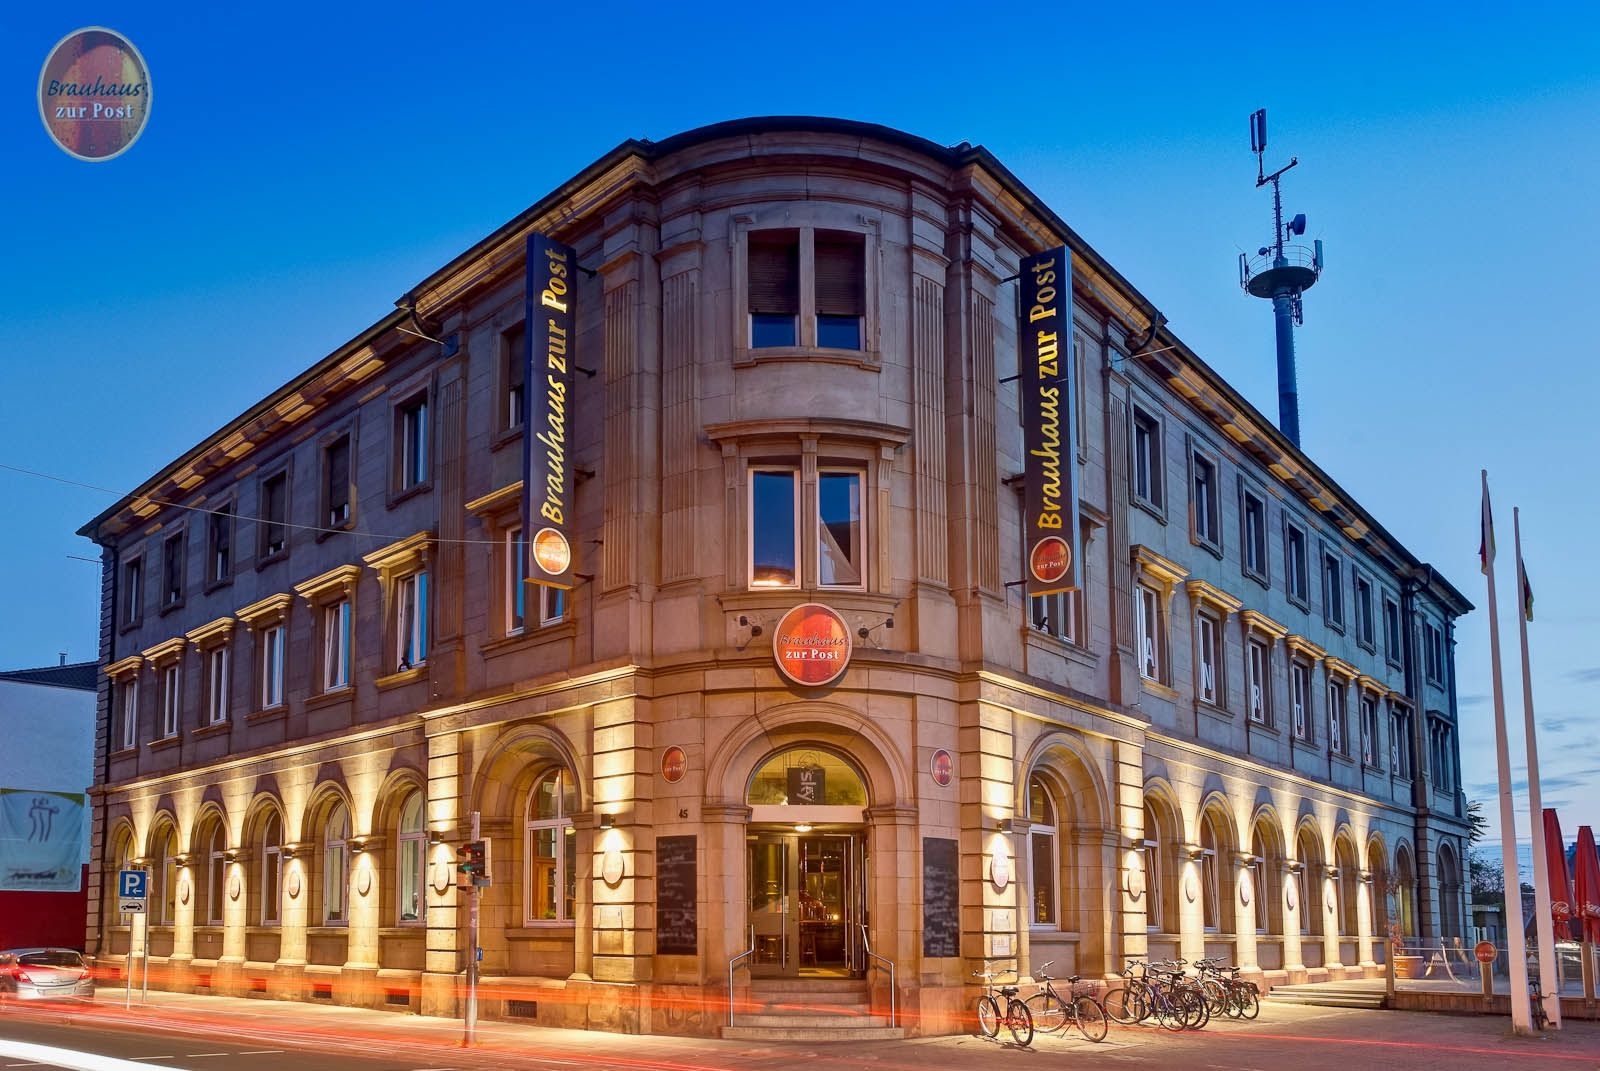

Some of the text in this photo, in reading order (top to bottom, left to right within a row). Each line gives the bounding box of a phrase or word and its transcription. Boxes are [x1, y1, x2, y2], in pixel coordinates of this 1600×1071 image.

[541, 248, 568, 314] Post
[1029, 257, 1057, 323] Post
[548, 319, 567, 374] zur
[1037, 330, 1058, 380] zur
[536, 375, 566, 525] Brauhaus
[1030, 386, 1063, 529] Brauhaus
[780, 631, 845, 647] Brauhaus
[785, 648, 840, 660] zur Post
[125, 874, 140, 894] P
